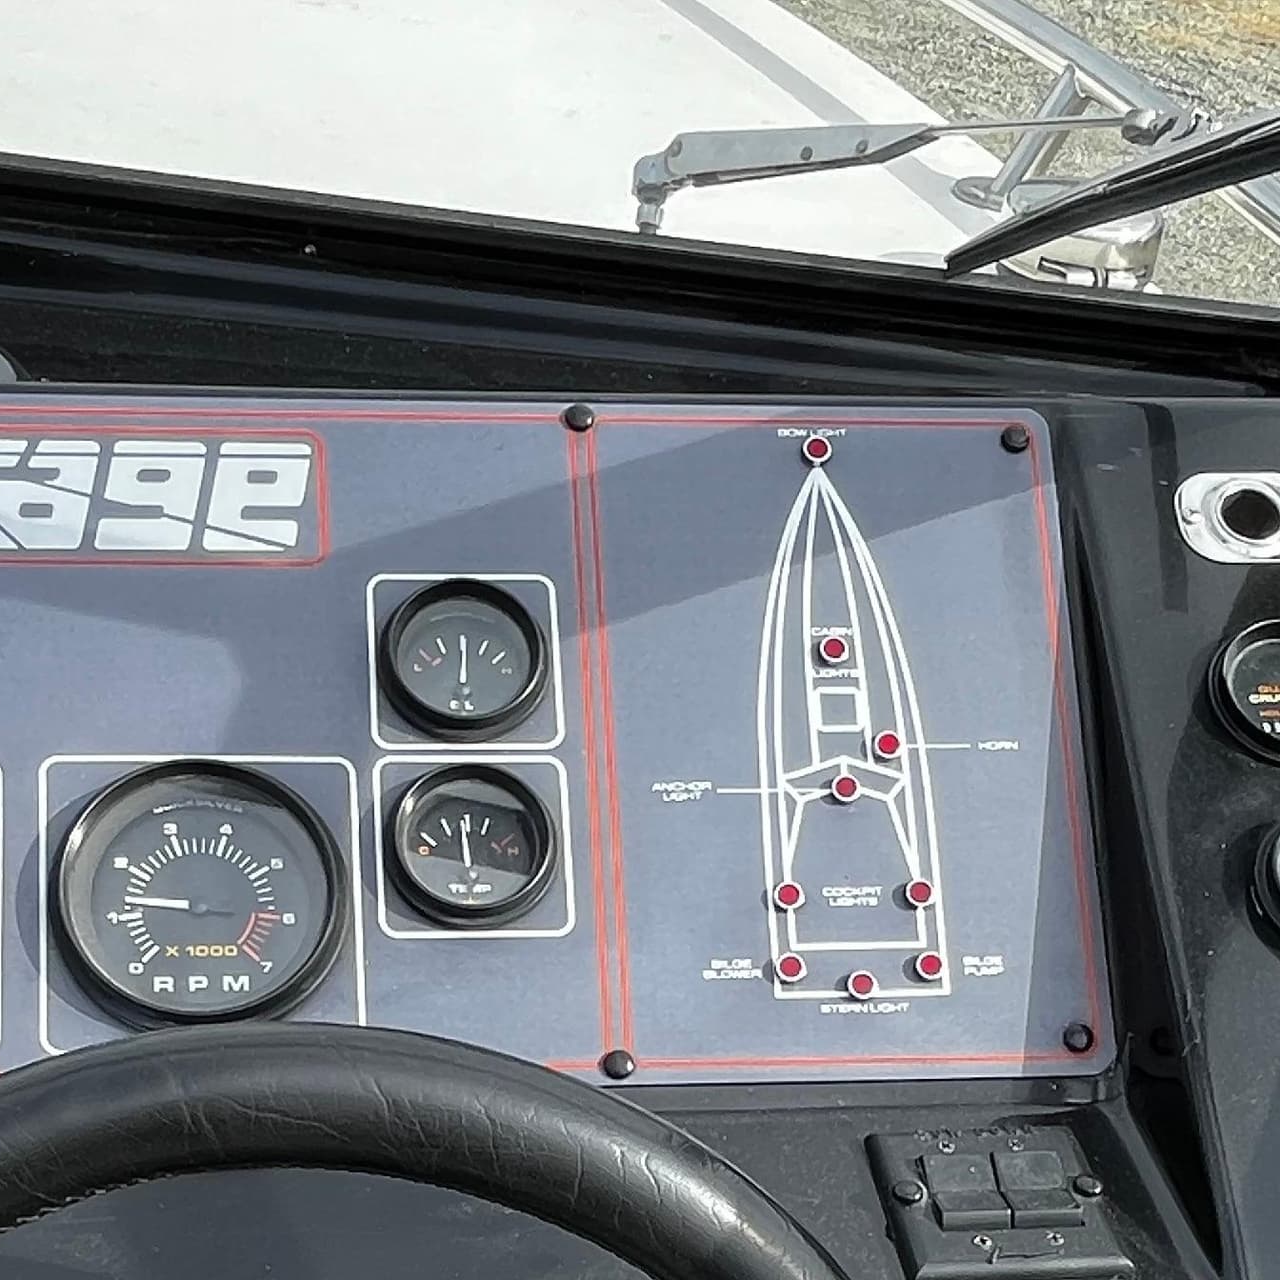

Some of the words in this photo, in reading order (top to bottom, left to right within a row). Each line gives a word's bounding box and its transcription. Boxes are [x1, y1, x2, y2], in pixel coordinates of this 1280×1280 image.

[449, 700, 475, 711] OL
[163, 823, 178, 836] 3
[220, 823, 234, 836] 4
[822, 886, 883, 897] COCKPIT
[828, 896, 878, 908] LIGHTS
[185, 946, 238, 957] 1000
[702, 968, 763, 981] BLOWER
[820, 1003, 868, 1014] STERN
[870, 1002, 910, 1013] LIGHT
